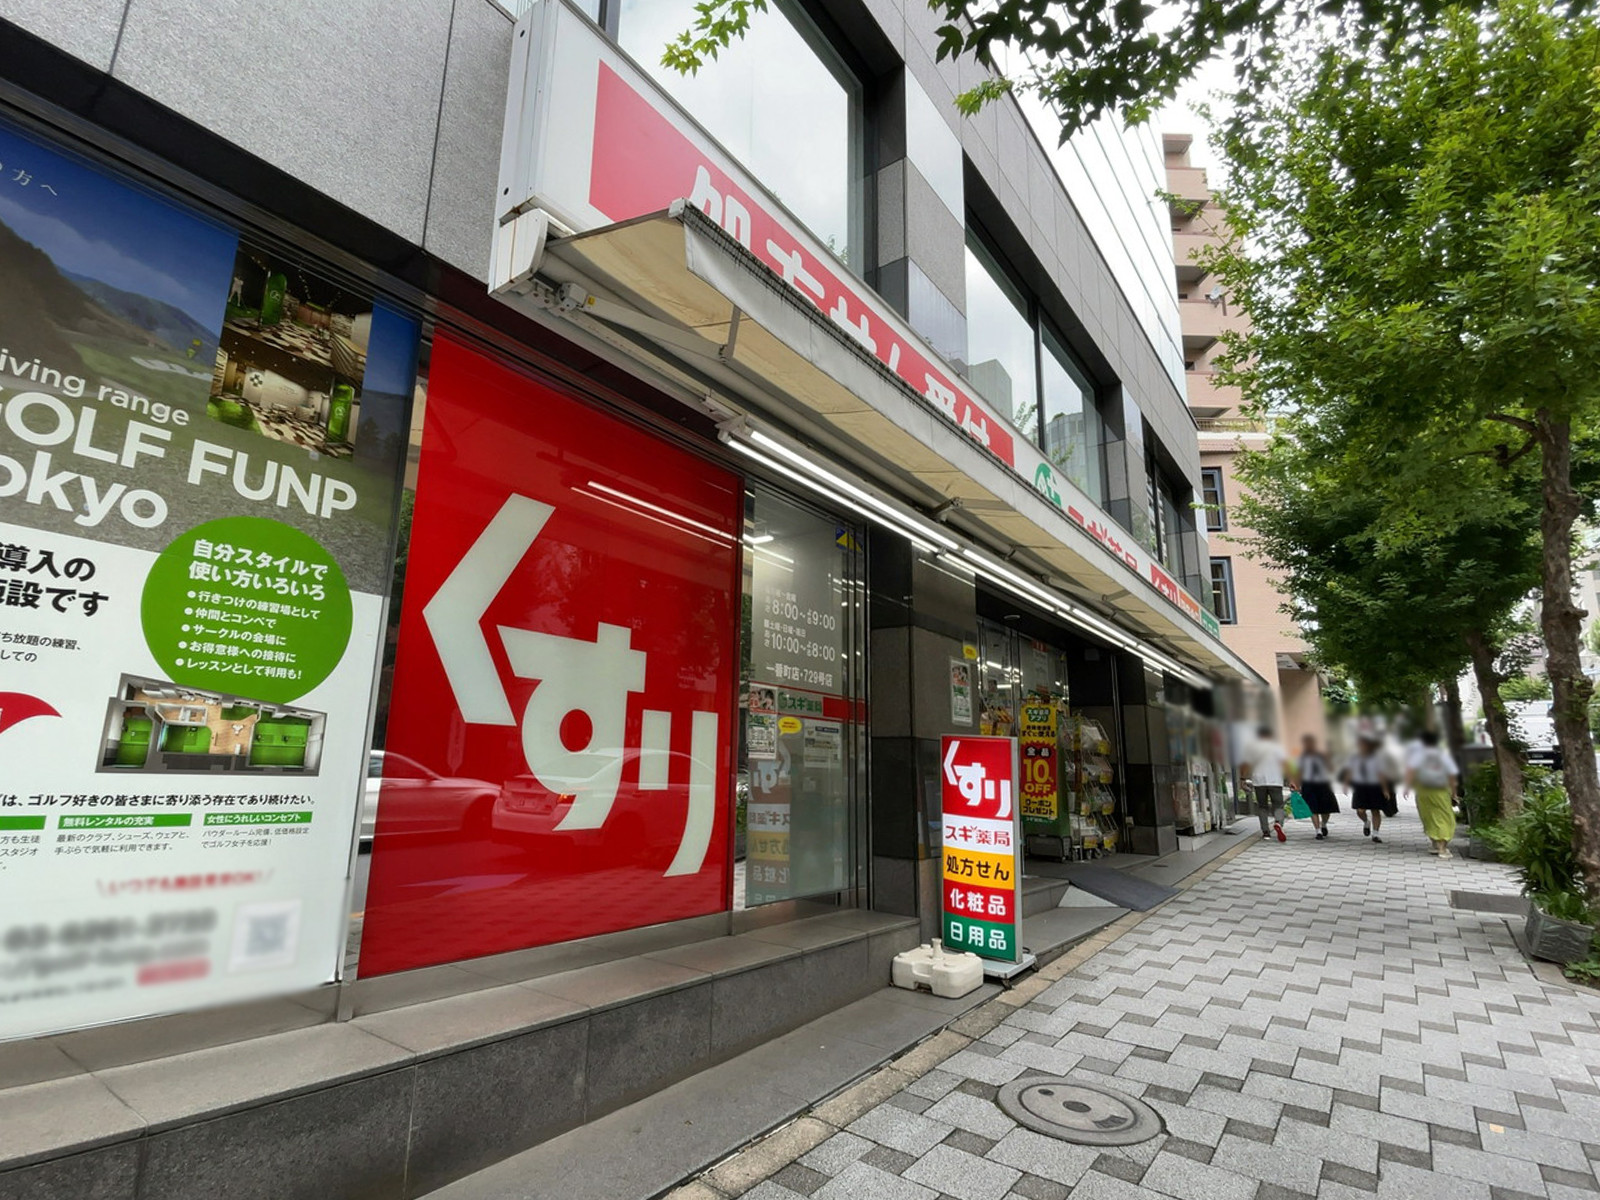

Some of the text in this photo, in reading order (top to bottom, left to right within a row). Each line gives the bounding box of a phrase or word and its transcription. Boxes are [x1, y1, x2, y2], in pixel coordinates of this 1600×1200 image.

[0, 162, 58, 197] 方へ
[97, 383, 191, 426] range
[0, 388, 358, 519] OLF FUNP
[0, 542, 97, 582] 導入の
[192, 538, 329, 582] 自分スタイルで
[188, 560, 326, 601] 使い方いろいろ
[194, 607, 277, 629] 仲間とコンペで
[197, 590, 321, 620] 行きつけの練習場として
[0, 631, 82, 651] ち放題の練習、
[192, 623, 287, 646] サークルの会場に
[188, 640, 297, 664] お得意様への接待に
[422, 492, 719, 878] くすり
[943, 740, 1011, 817] くすり
[1024, 782, 1052, 794] OFF
[0, 793, 315, 807] は、ゴルフ好きの皆さまに寄り添う存在であり続けたい。
[62, 816, 155, 828] 無料レンタルの充実
[206, 813, 301, 824] 女性にうれしいコンセプト
[945, 825, 1011, 848] スギ薬局
[946, 854, 1010, 882] 処方せん
[949, 887, 1007, 916] 化粧品
[950, 921, 1008, 951] 日用品
